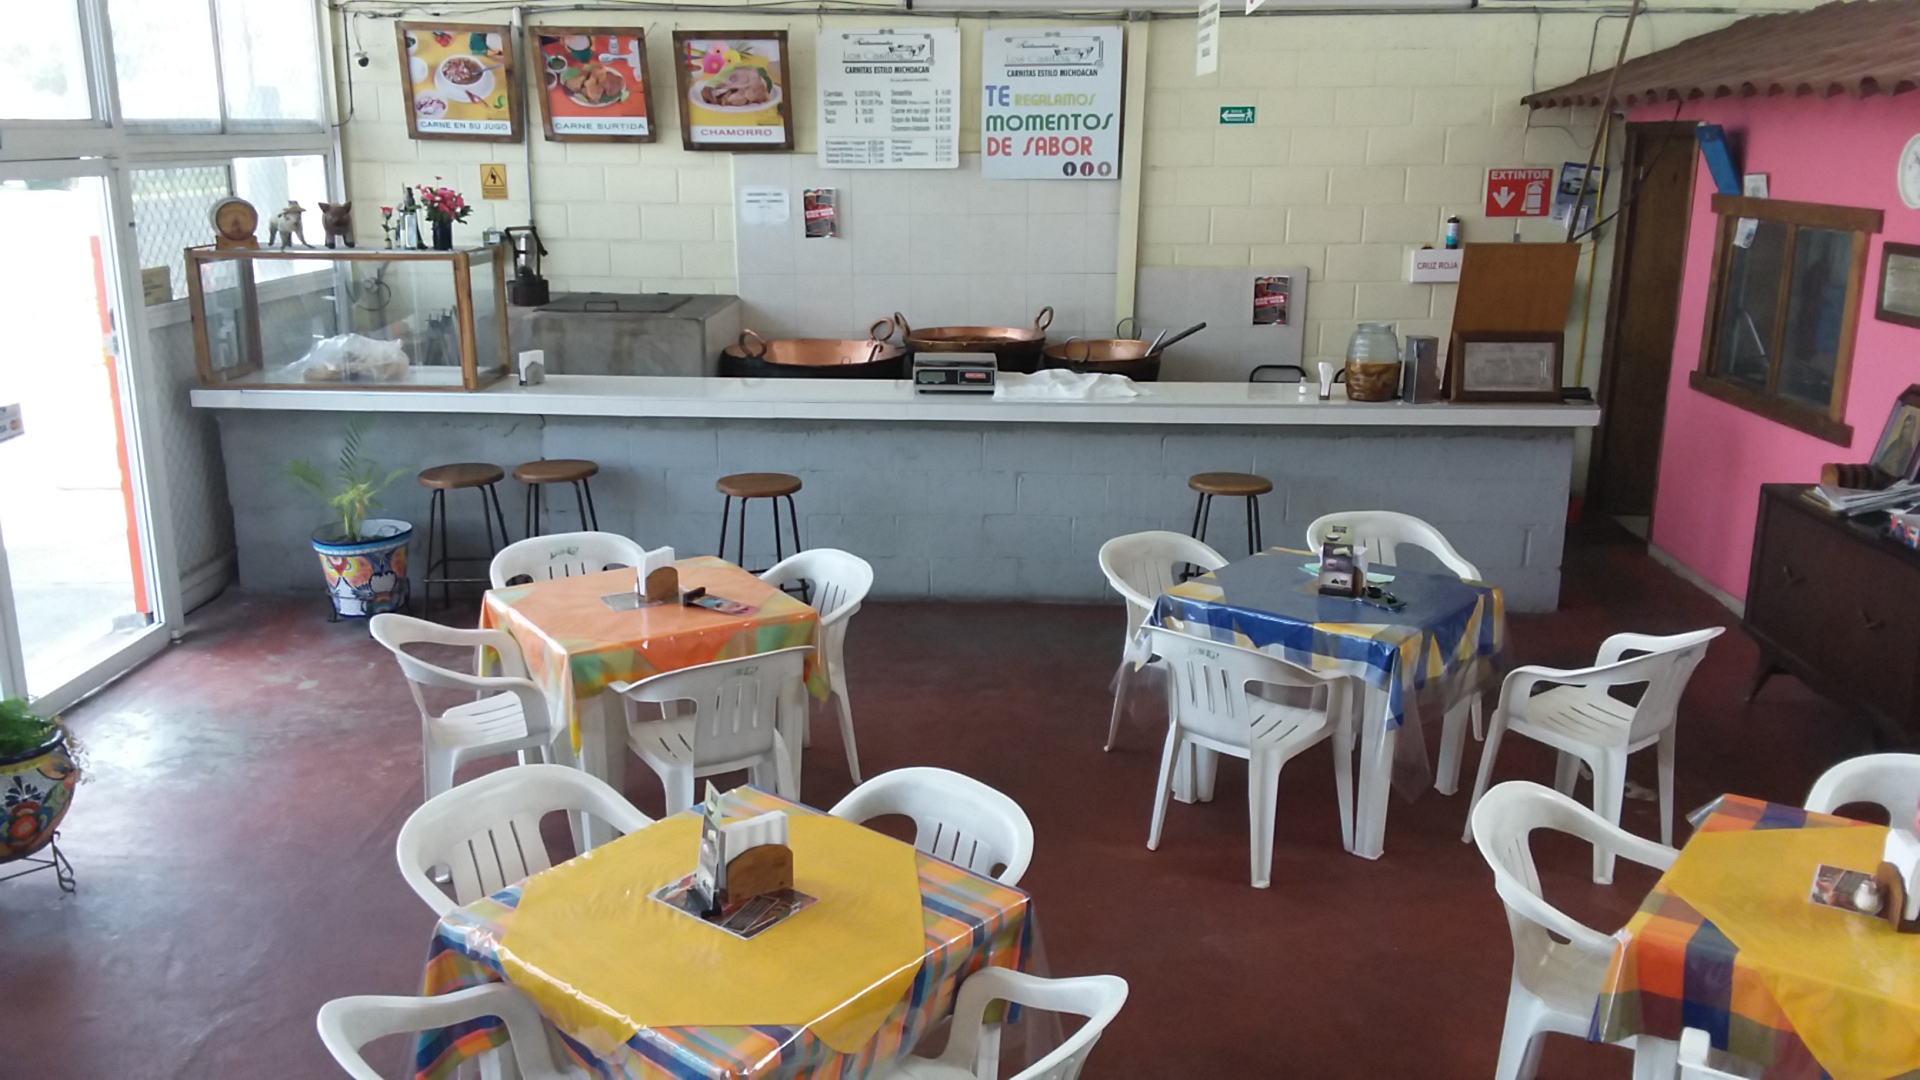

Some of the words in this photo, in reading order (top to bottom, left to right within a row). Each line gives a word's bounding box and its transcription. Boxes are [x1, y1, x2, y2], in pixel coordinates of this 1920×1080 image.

[845, 66, 873, 74] CARNITAS
[874, 66, 893, 74] ESTILO
[894, 66, 930, 74] MICHOACAN
[1007, 69, 1036, 77] CARNITAS
[1038, 69, 1058, 77] ESTILO
[1060, 68, 1098, 76] MICHOACAN
[985, 85, 1010, 107] TE
[1014, 92, 1096, 106] REGALAMOS
[420, 121, 451, 129] CARNE
[483, 123, 508, 131] JUGO
[554, 122, 593, 130] CARNE
[597, 122, 645, 130] SURTIDA
[986, 112, 1114, 131] MOMENTOS
[700, 128, 773, 137] CHAMORRO
[987, 136, 1012, 156] DE
[1023, 136, 1093, 156] SABOR
[1490, 169, 1550, 181] EXTINTOR
[1417, 262, 1437, 270] CRUZ
[1439, 262, 1458, 270] ROJA
